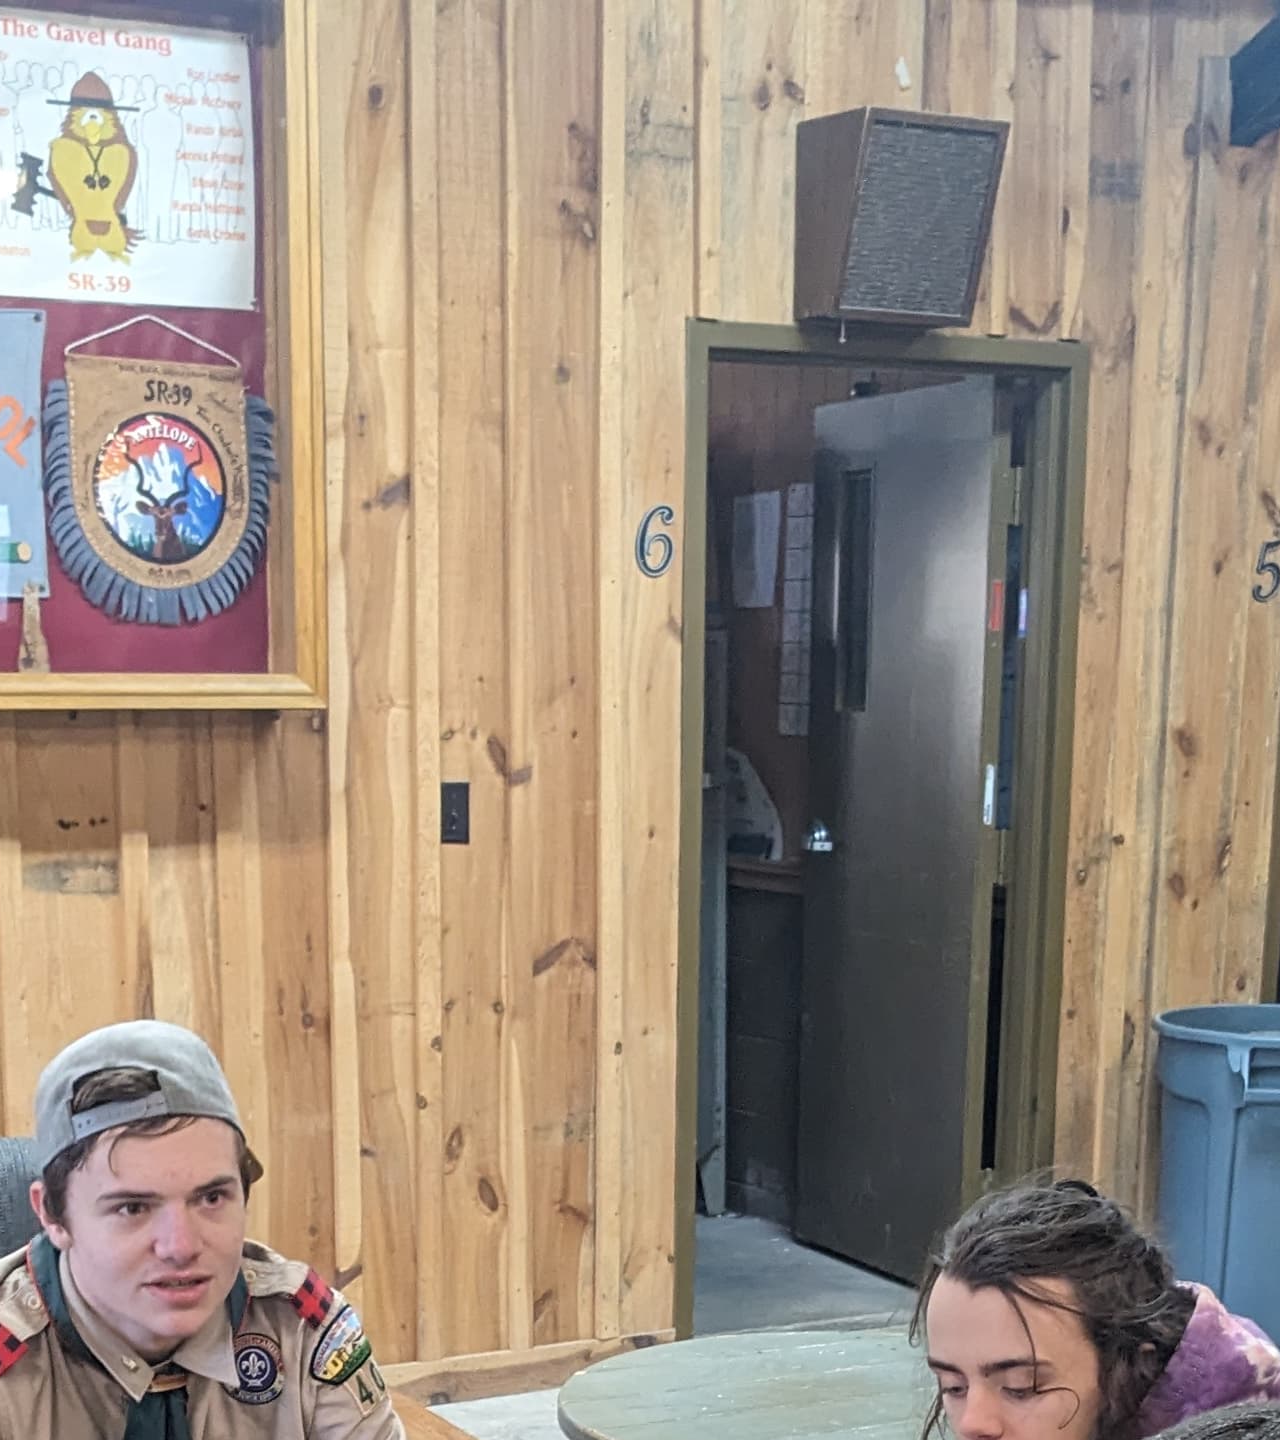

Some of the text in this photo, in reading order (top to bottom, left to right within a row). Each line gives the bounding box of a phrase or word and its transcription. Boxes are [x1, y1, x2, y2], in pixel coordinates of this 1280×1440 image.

[0, 16, 172, 56] The Gavel Gang
[67, 271, 132, 293] SR-39
[143, 379, 193, 407] SR-39
[634, 504, 675, 579] 6
